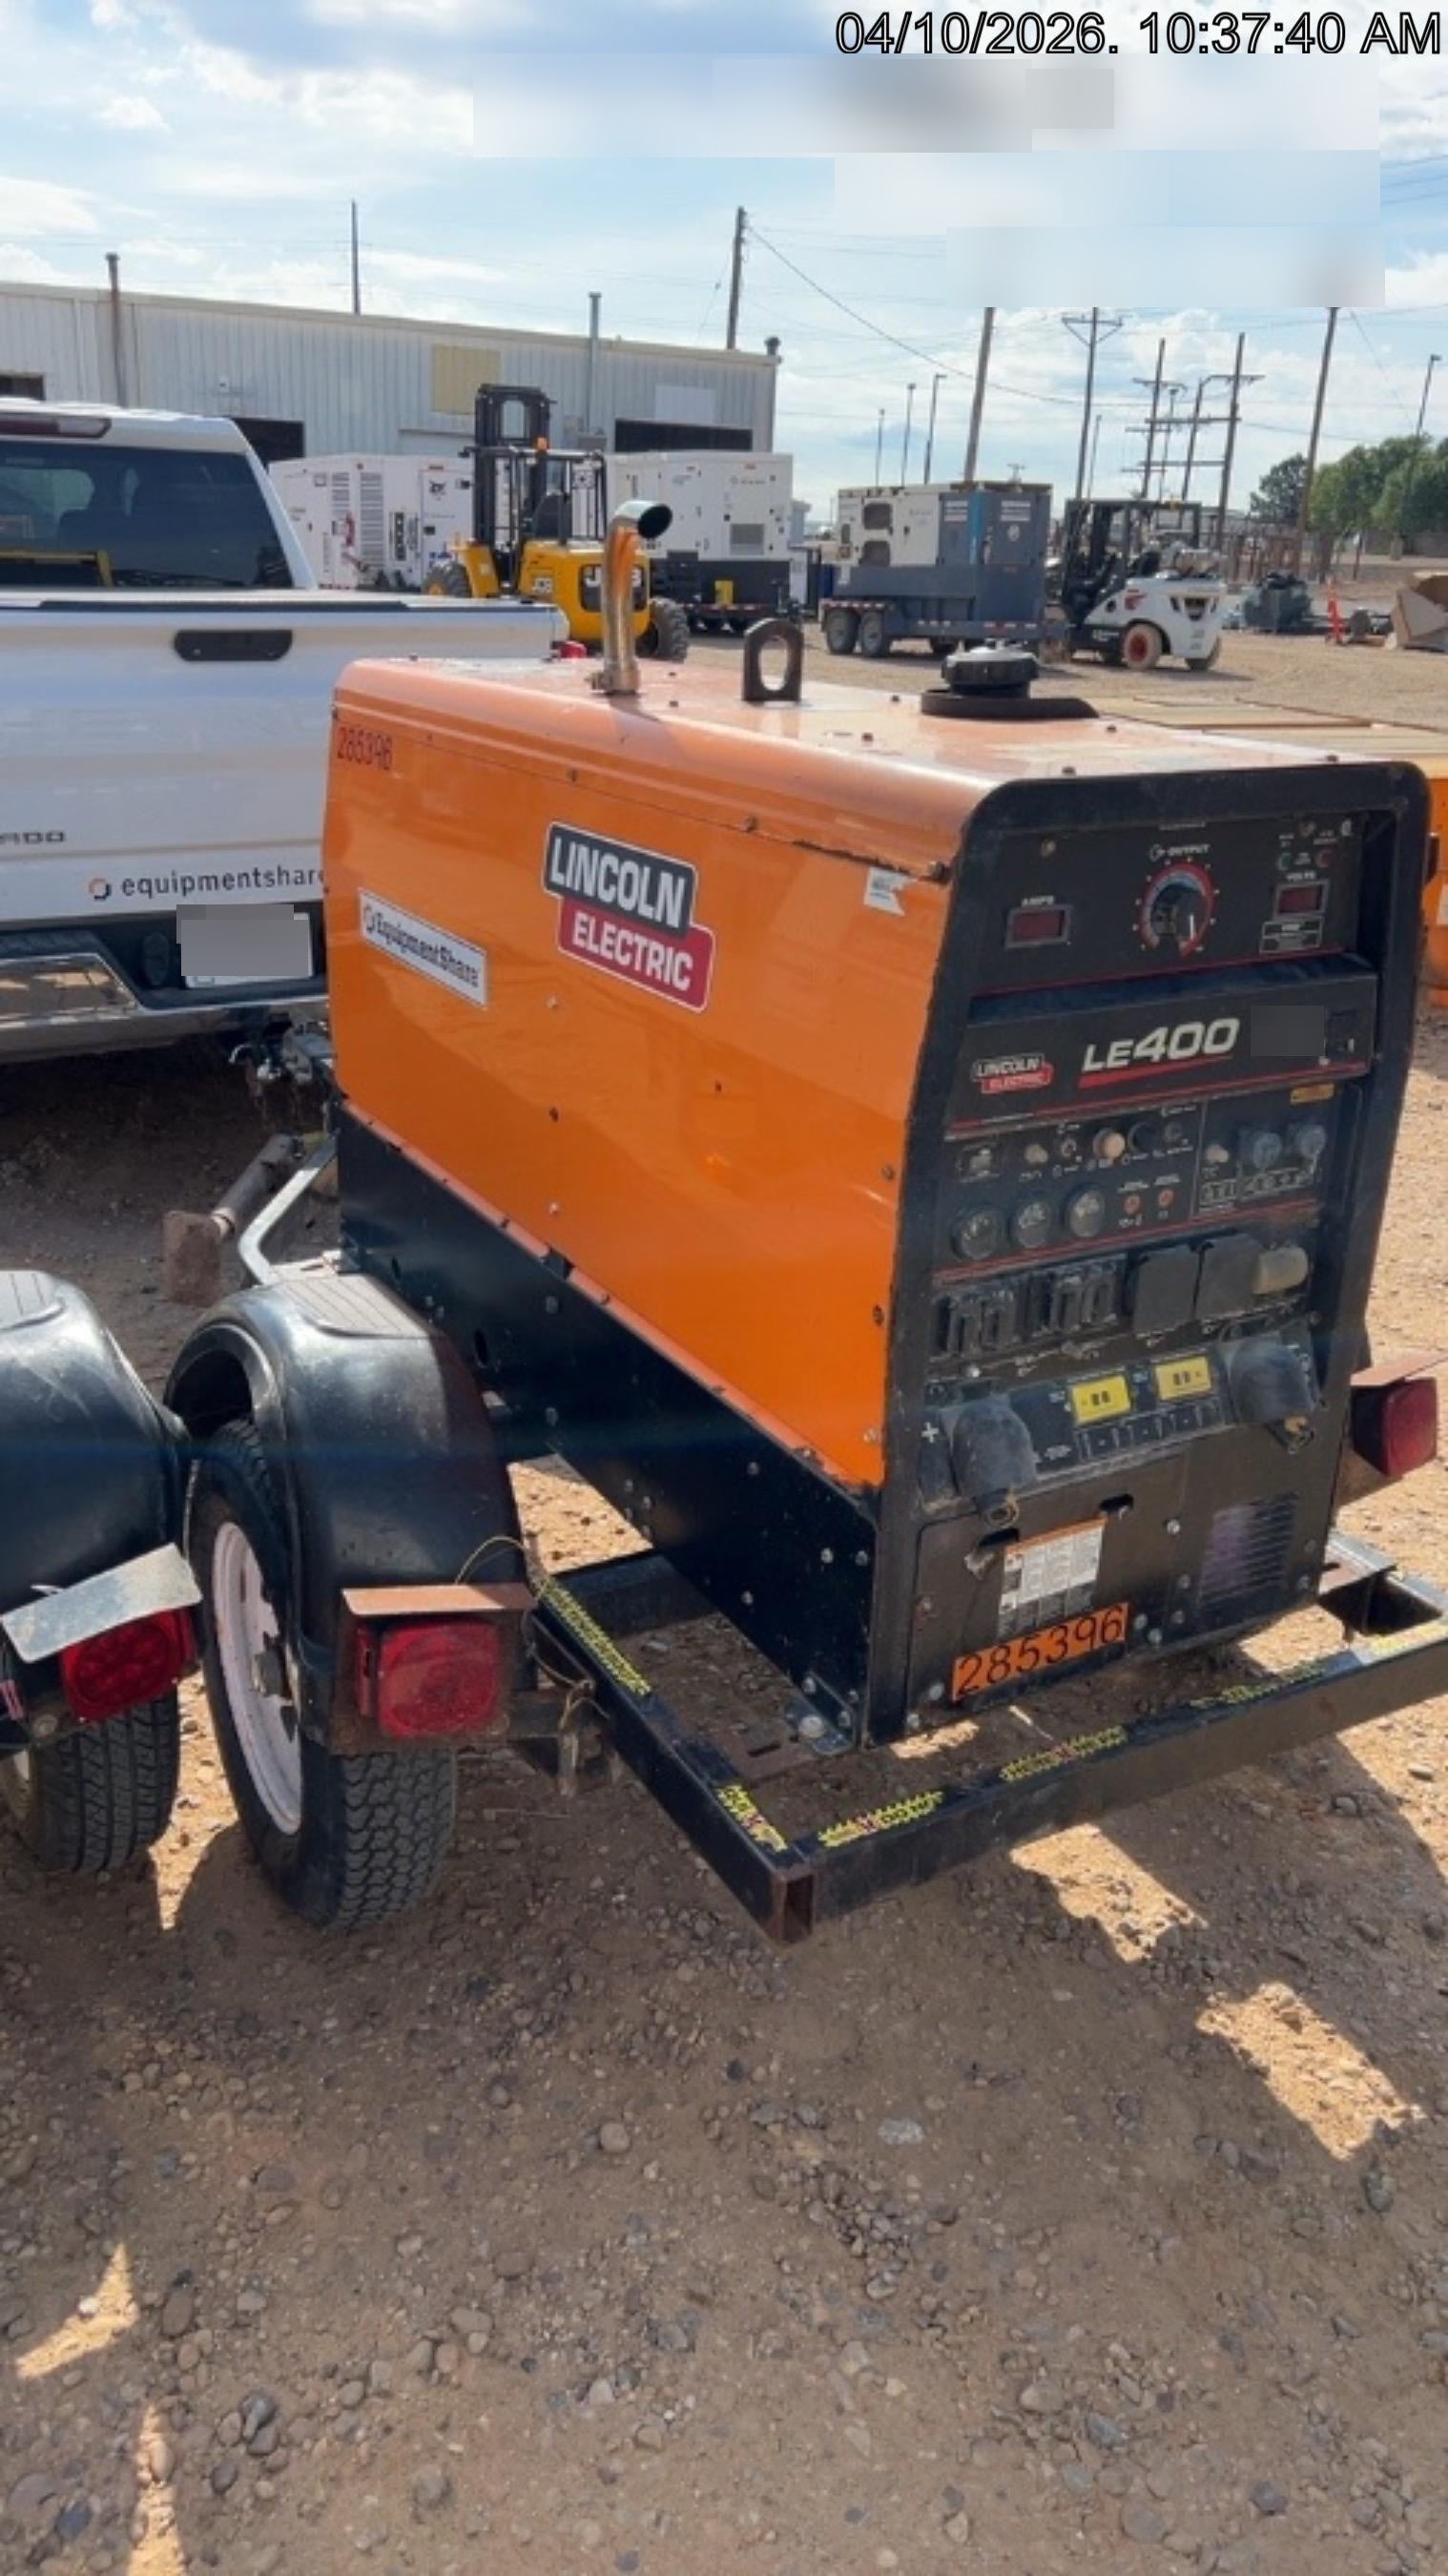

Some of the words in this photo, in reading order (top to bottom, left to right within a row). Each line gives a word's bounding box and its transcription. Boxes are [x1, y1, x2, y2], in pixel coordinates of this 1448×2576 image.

[550, 837, 685, 929] LINCOLN
[377, 912, 479, 987] EquipmentShare
[573, 911, 693, 991] ELECTRIC
[977, 1057, 1040, 1077] LINCOLN
[1082, 1018, 1240, 1072] LE400
[956, 1605, 1124, 1695] 285396
